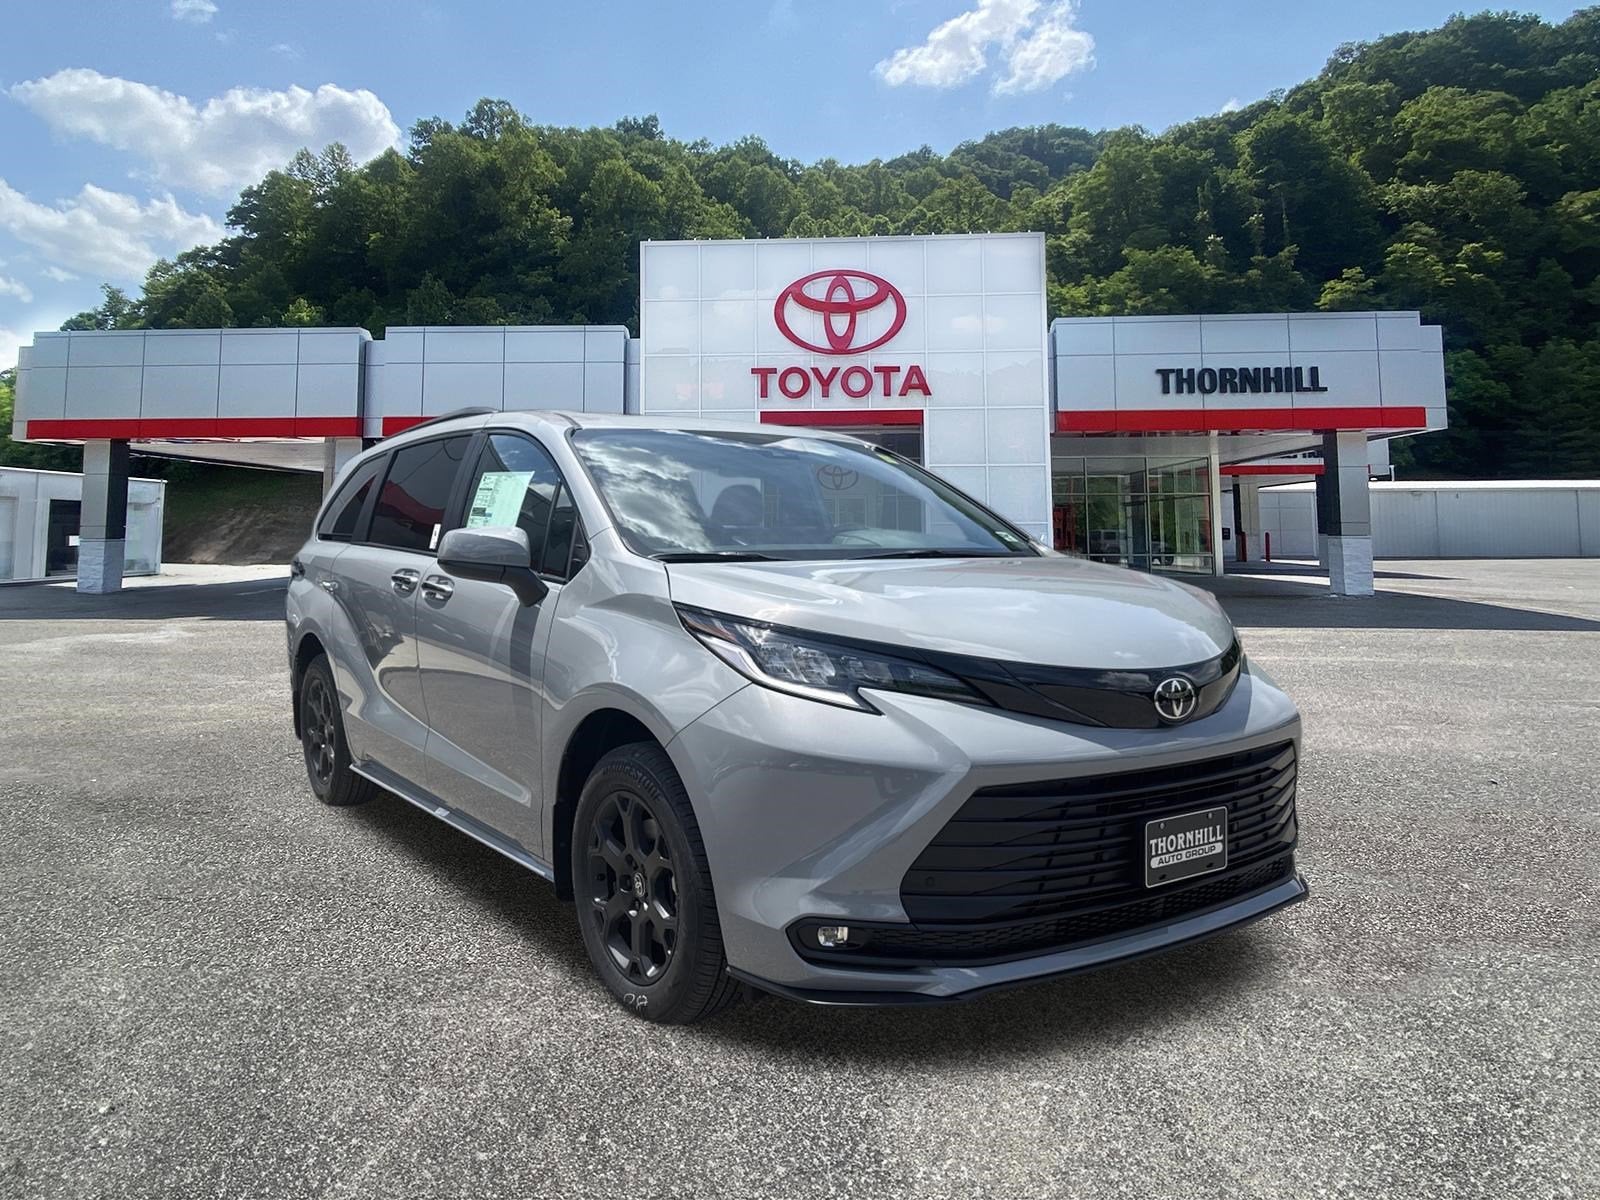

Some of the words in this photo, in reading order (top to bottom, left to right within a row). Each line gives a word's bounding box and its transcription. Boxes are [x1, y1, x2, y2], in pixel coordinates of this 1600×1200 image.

[751, 366, 932, 399] TOYOTA
[1156, 366, 1328, 394] THORNHILL
[1149, 825, 1224, 856] THORNHILL
[1157, 854, 1183, 866] AUTO
[1185, 845, 1217, 859] GROUP
